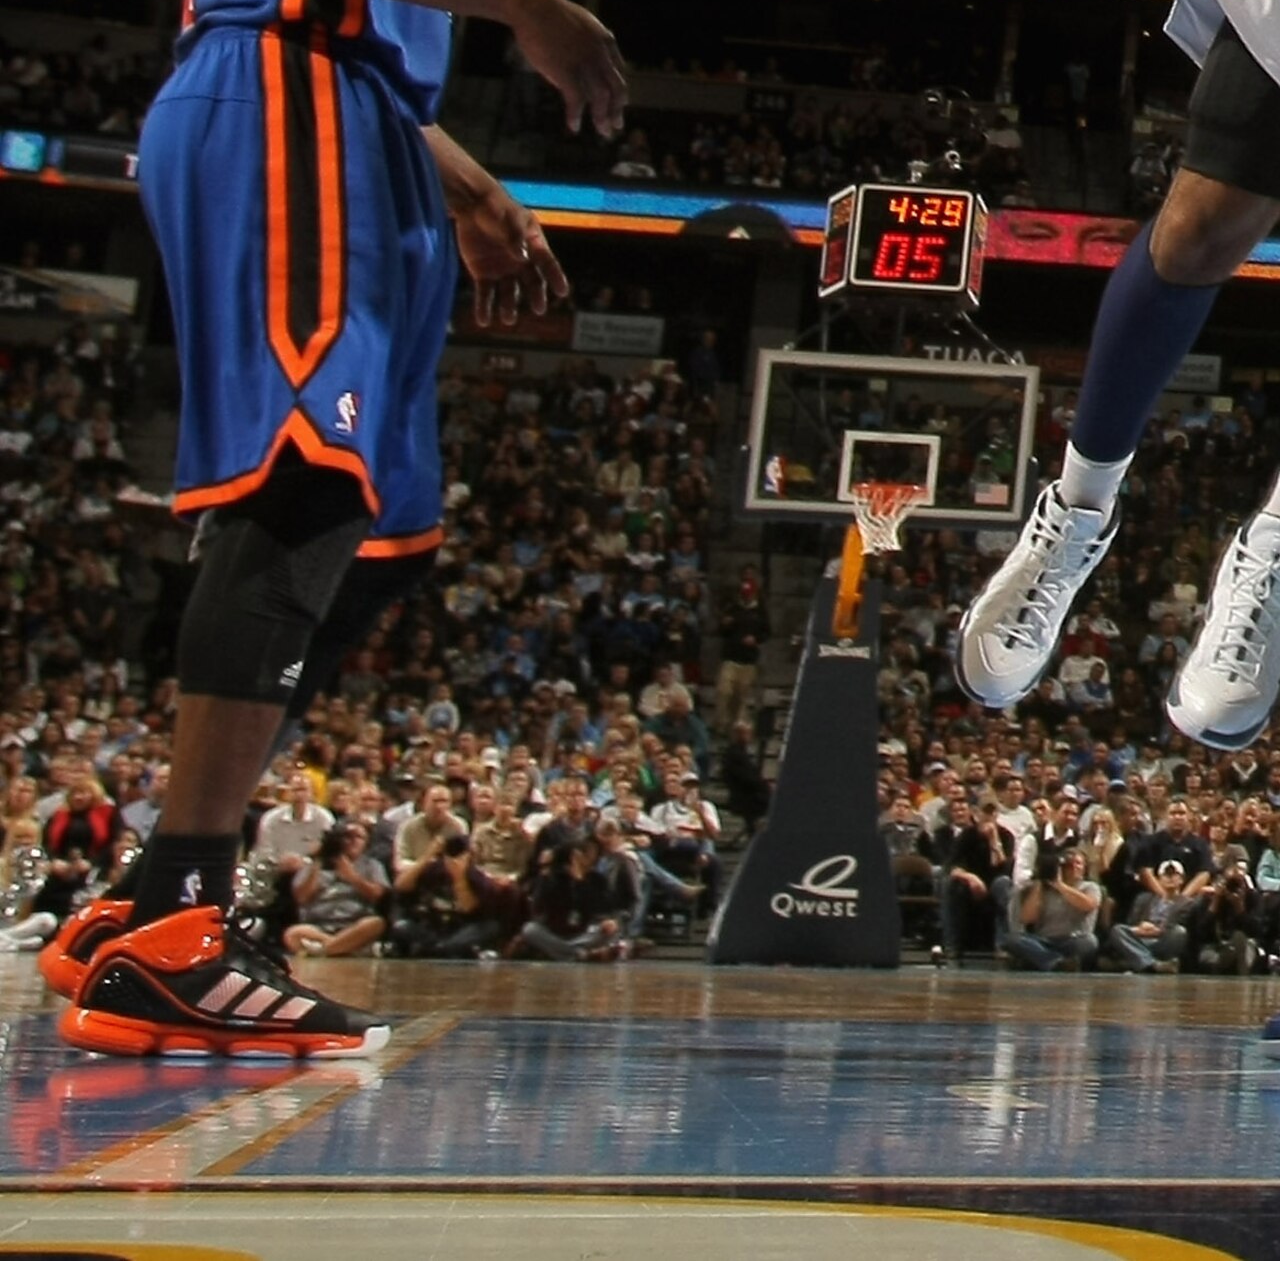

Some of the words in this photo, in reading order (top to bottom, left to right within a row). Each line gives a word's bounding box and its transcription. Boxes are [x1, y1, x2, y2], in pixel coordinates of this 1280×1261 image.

[888, 195, 966, 228] 4:29
[871, 232, 949, 281] 05
[769, 891, 860, 920] Qwest
